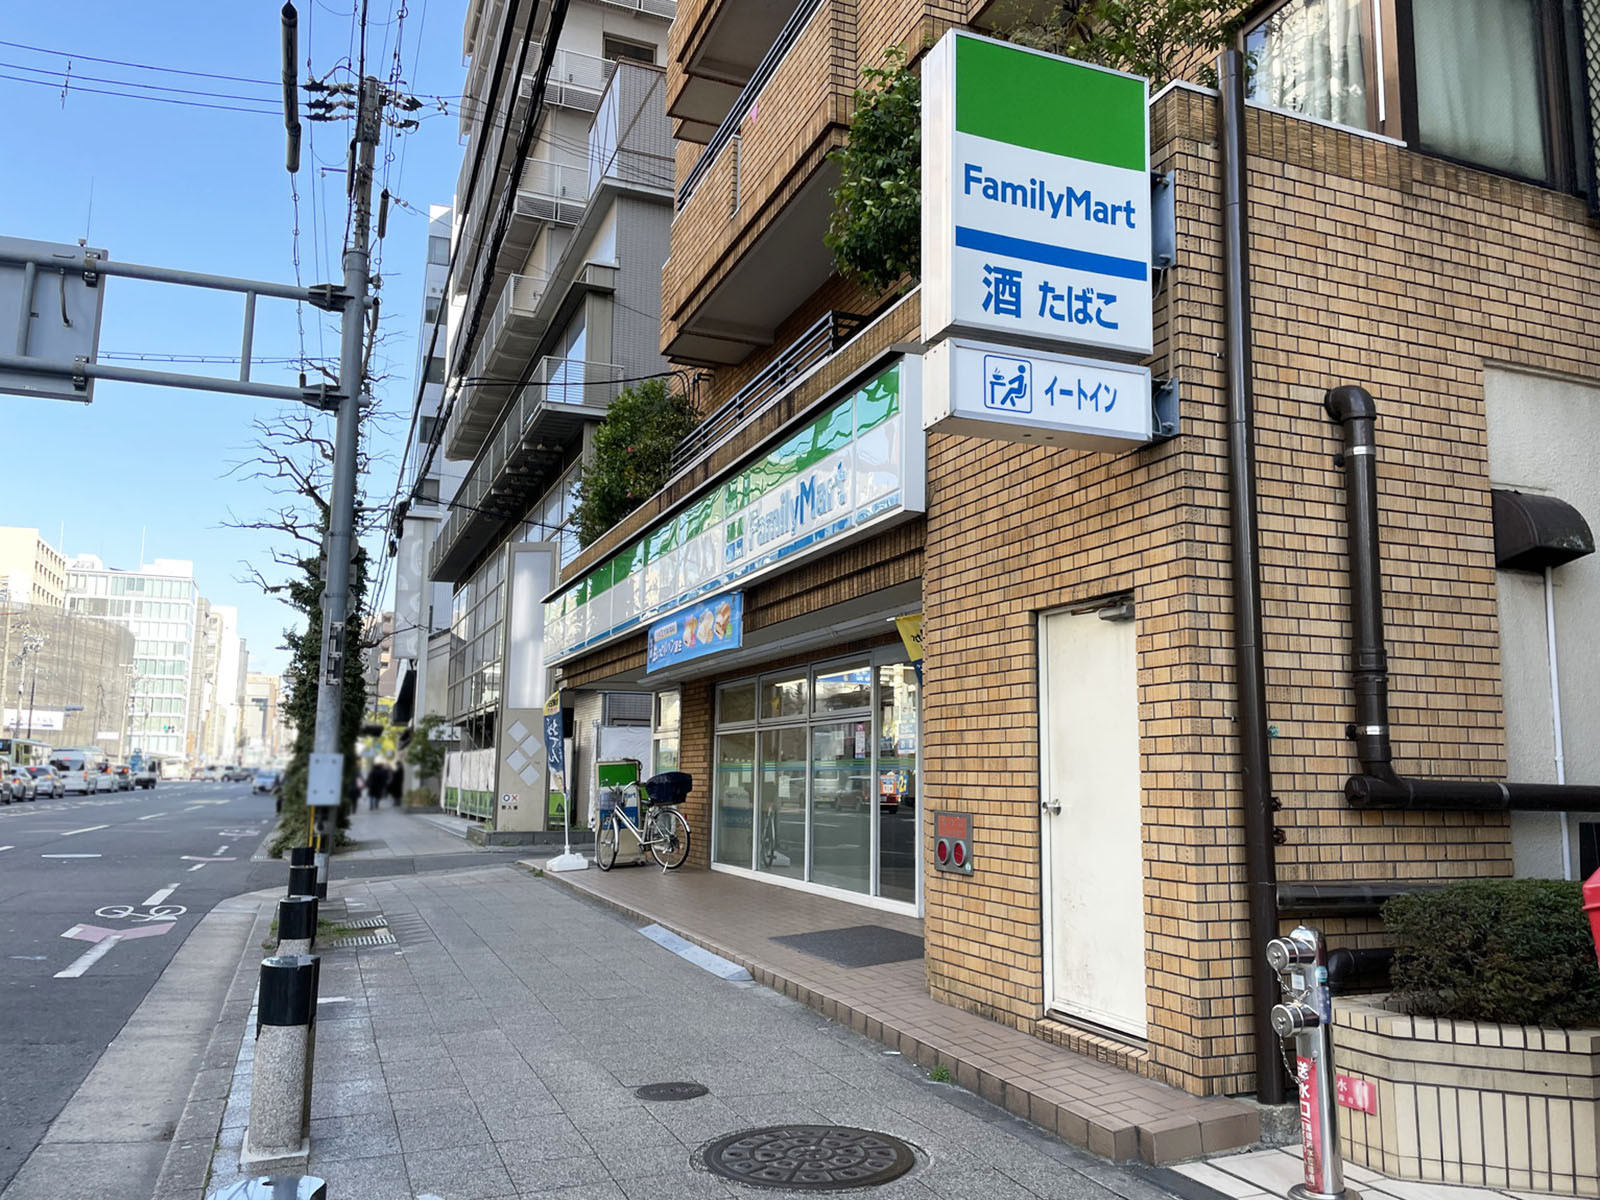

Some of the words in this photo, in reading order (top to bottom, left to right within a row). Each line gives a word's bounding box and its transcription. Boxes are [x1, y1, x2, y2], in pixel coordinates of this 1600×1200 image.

[963, 163, 1136, 229] FamilyMart
[982, 263, 1023, 318] 酒
[1038, 280, 1119, 330] たばこ
[1044, 375, 1118, 413] イートイン
[747, 461, 847, 552] FamilyMart
